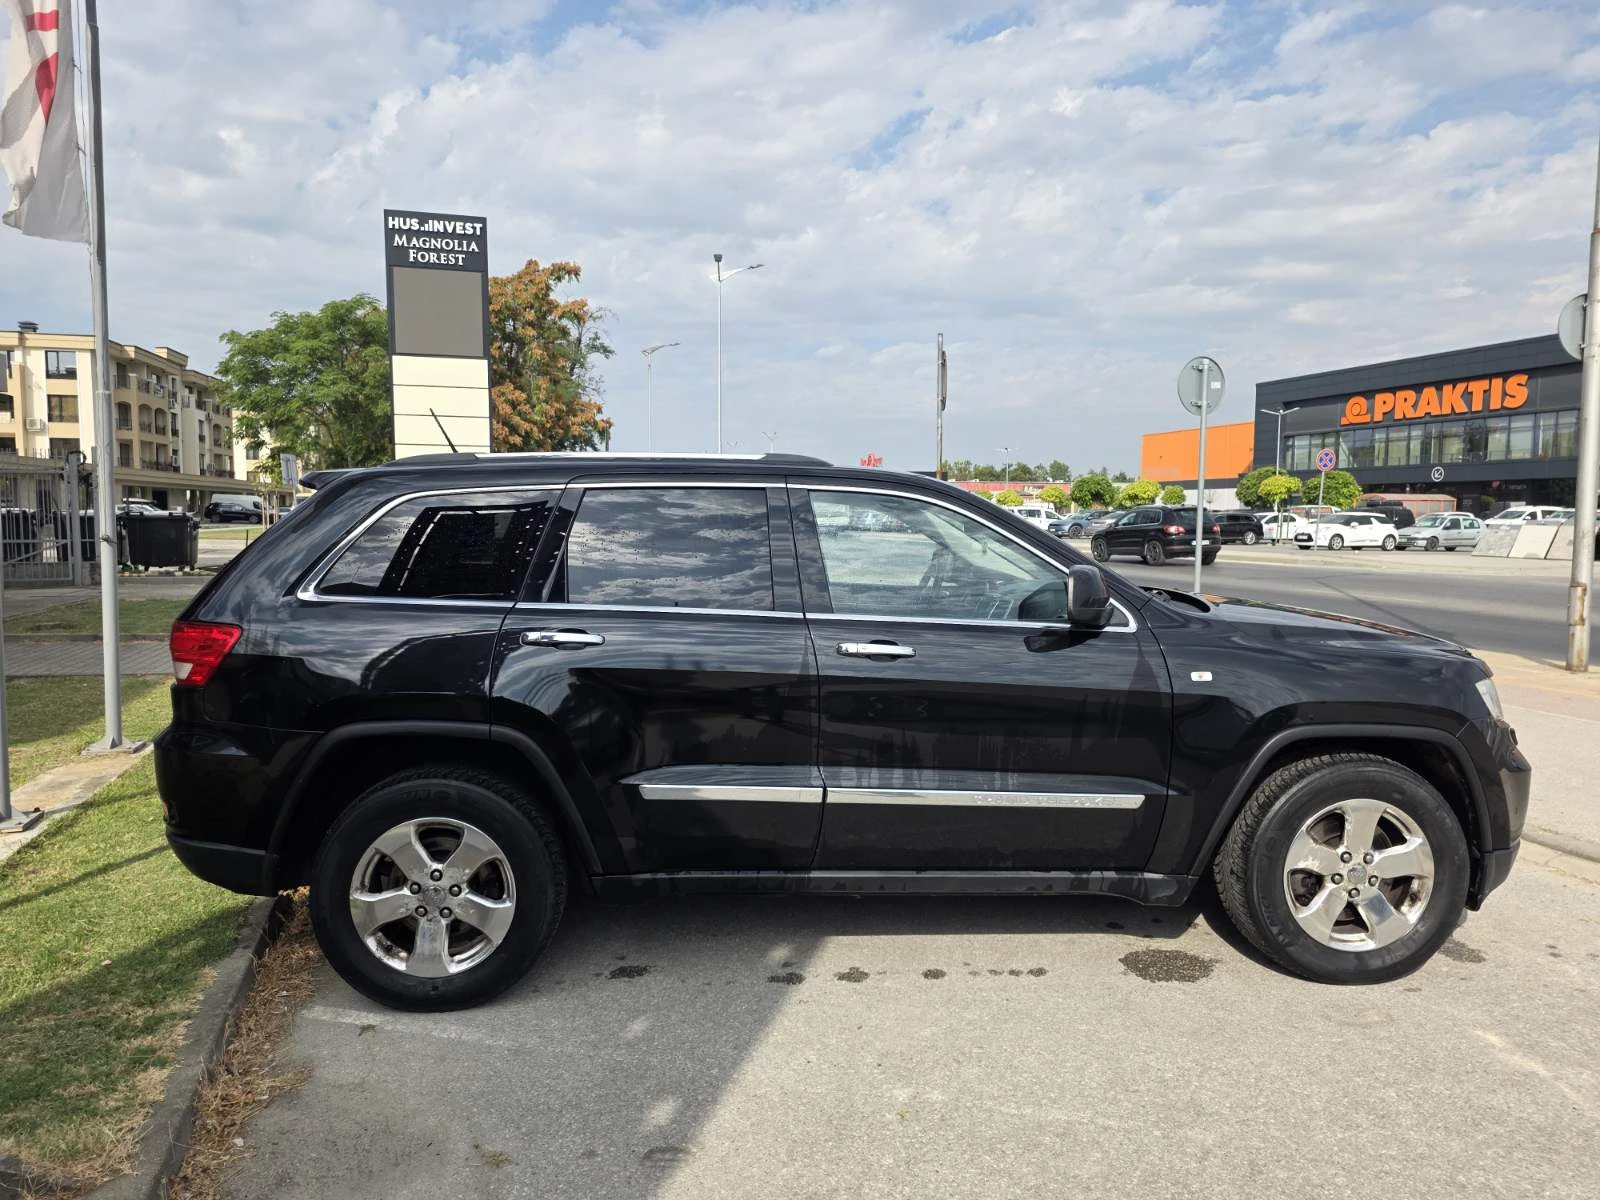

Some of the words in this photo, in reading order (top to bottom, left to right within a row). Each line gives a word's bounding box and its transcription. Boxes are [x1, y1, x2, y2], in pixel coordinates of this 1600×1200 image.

[393, 234, 479, 252] MAGNOLIA
[408, 249, 466, 265] FOREST
[1373, 373, 1529, 422] PRAKTIS
